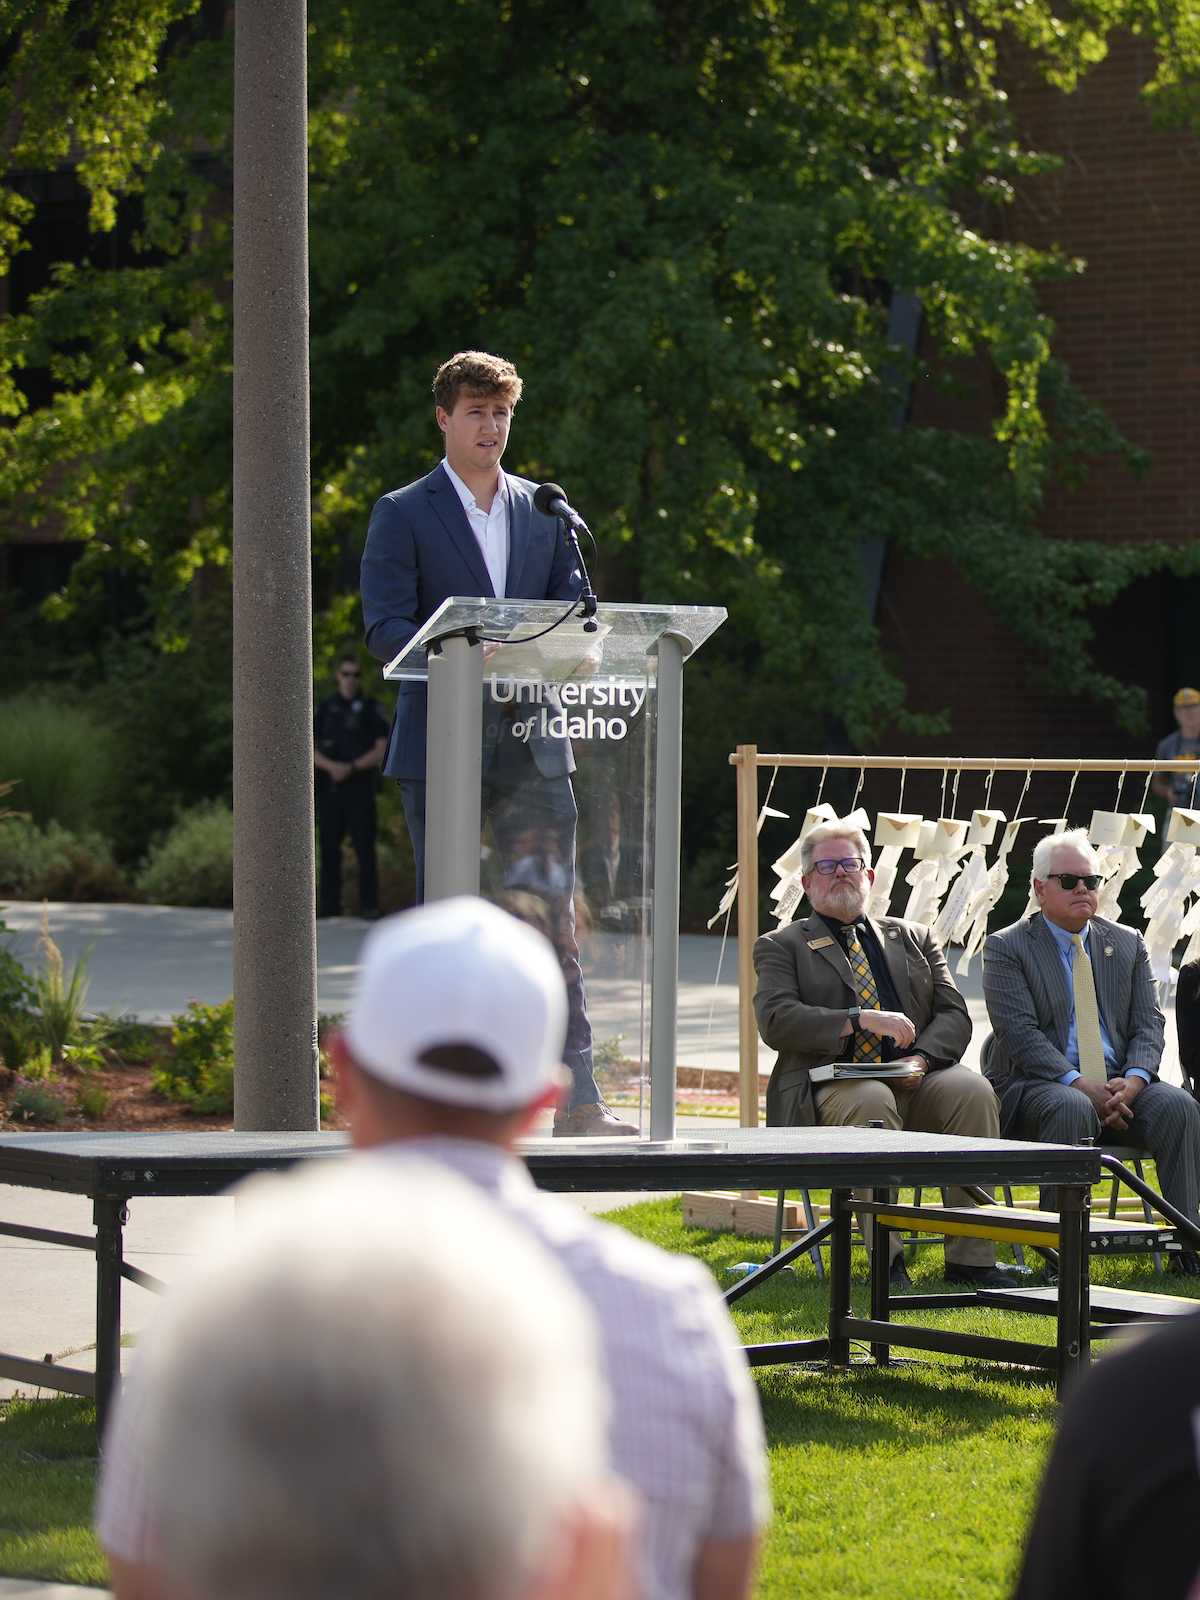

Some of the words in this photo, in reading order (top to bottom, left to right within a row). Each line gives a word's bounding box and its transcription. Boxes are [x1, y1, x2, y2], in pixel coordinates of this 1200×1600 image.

[490, 672, 646, 717] University
[511, 716, 537, 743] of
[541, 708, 627, 740] Idaho
